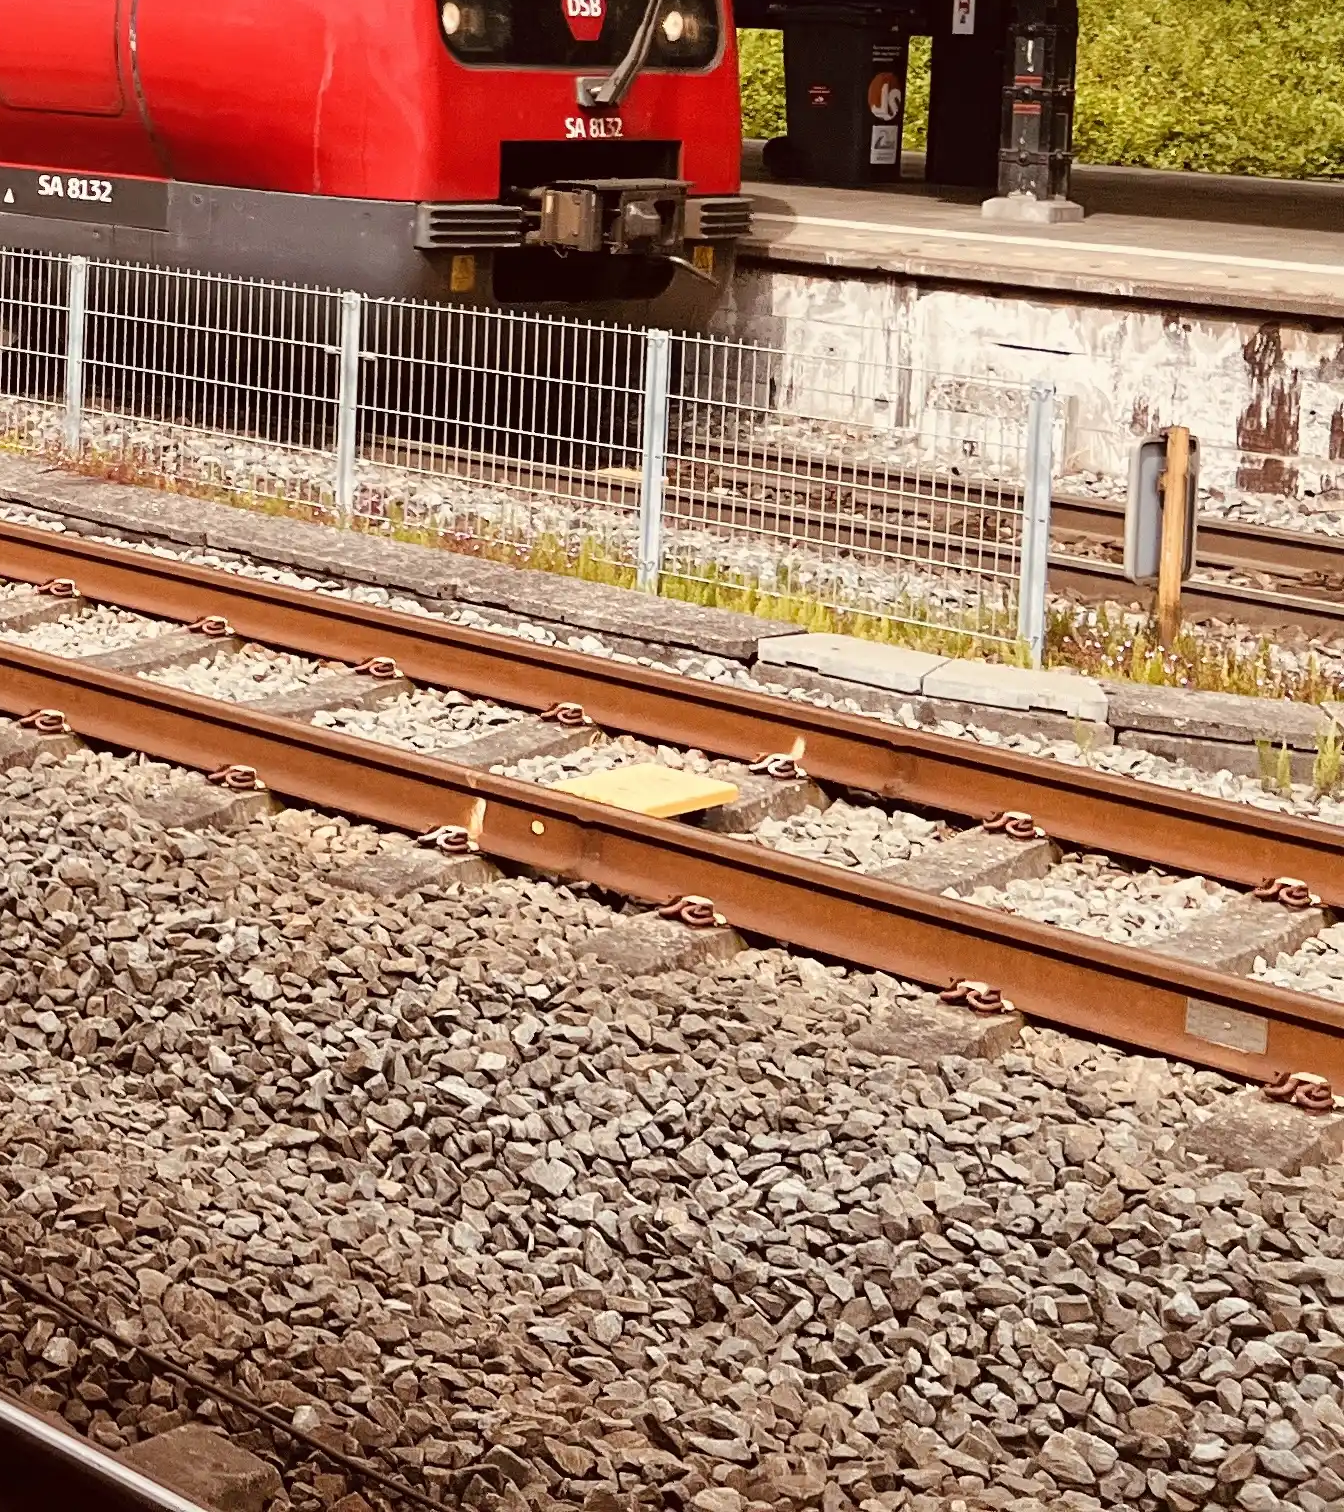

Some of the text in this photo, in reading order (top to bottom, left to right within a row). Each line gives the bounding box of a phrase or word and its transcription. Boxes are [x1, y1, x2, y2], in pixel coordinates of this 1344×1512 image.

[565, 117, 624, 139] SA 8132
[37, 174, 113, 204] SA 8132
